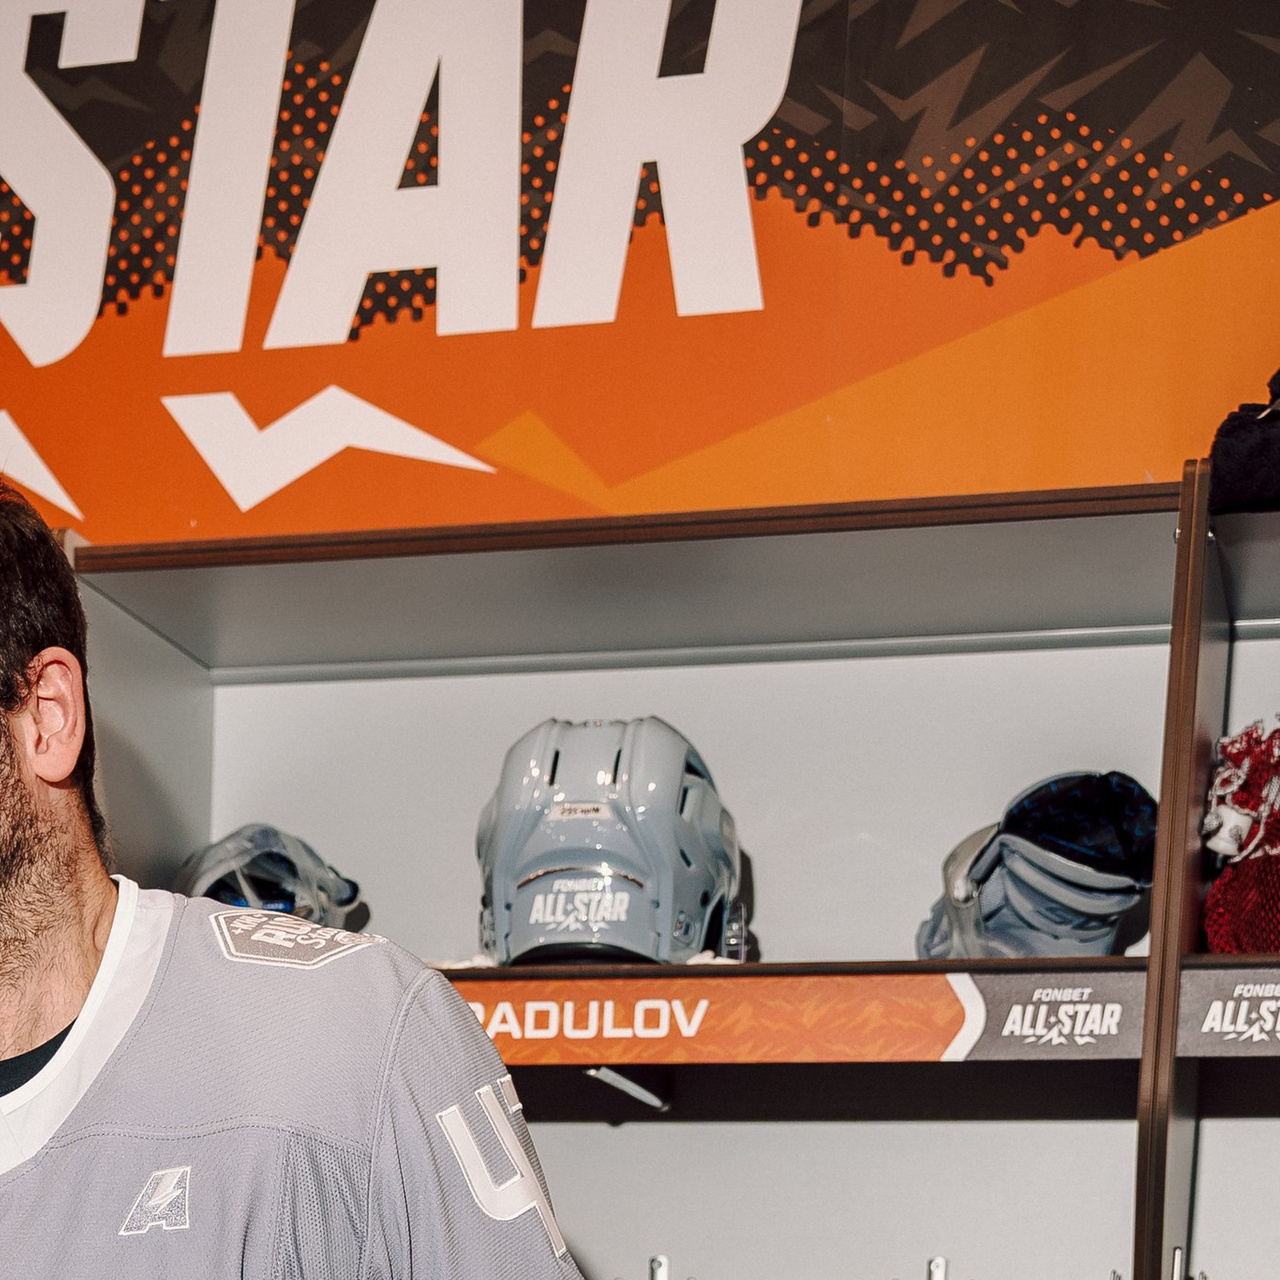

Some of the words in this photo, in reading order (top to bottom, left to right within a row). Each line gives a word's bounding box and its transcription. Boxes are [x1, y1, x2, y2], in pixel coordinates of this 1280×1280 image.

[529, 893, 567, 924] ALL
[1032, 987, 1093, 1002] FONBET
[1001, 1004, 1048, 1037] ALL
[1057, 1002, 1122, 1036] STAR
[1200, 1000, 1250, 1033] ALL
